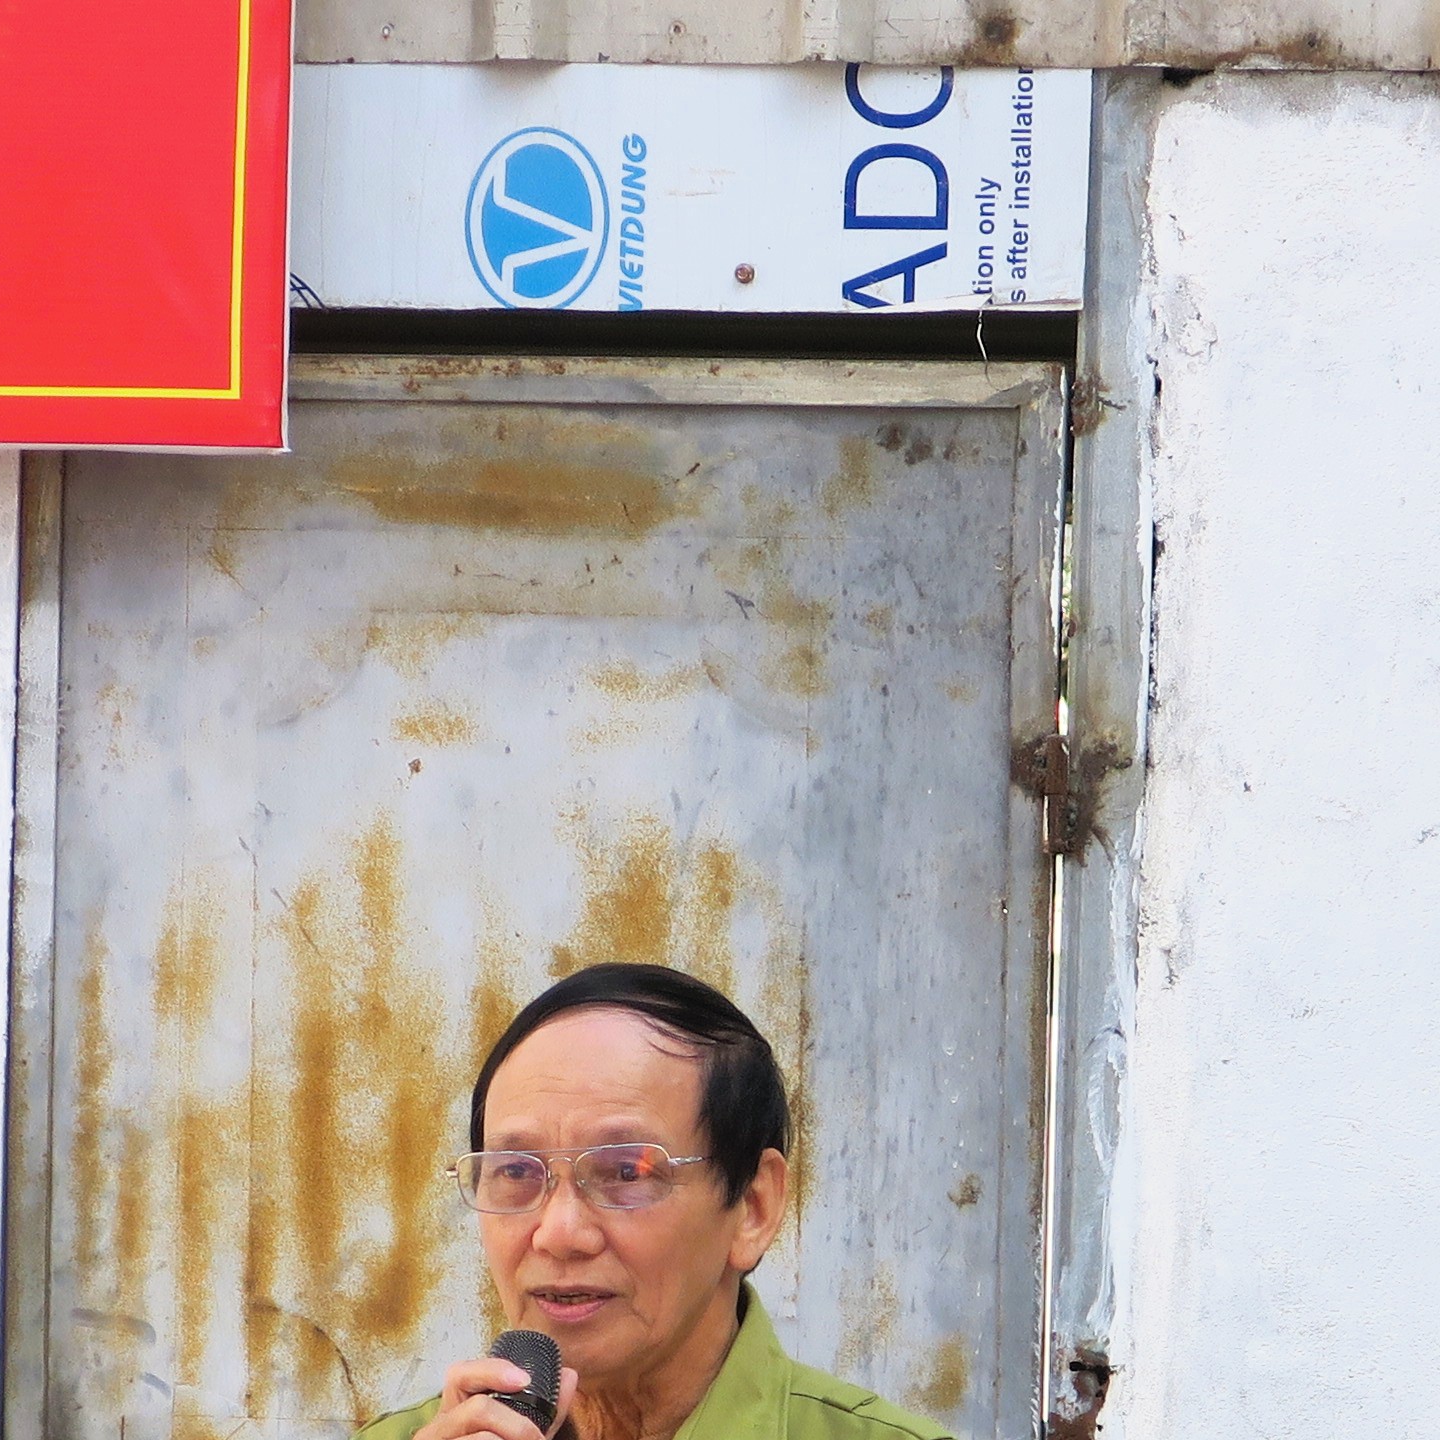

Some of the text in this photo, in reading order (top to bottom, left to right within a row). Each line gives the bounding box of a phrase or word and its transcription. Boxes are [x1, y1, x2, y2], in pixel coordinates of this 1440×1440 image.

[617, 132, 648, 312] VIETDUNG
[971, 176, 1002, 296] tion only
[1006, 218, 1029, 280] after
